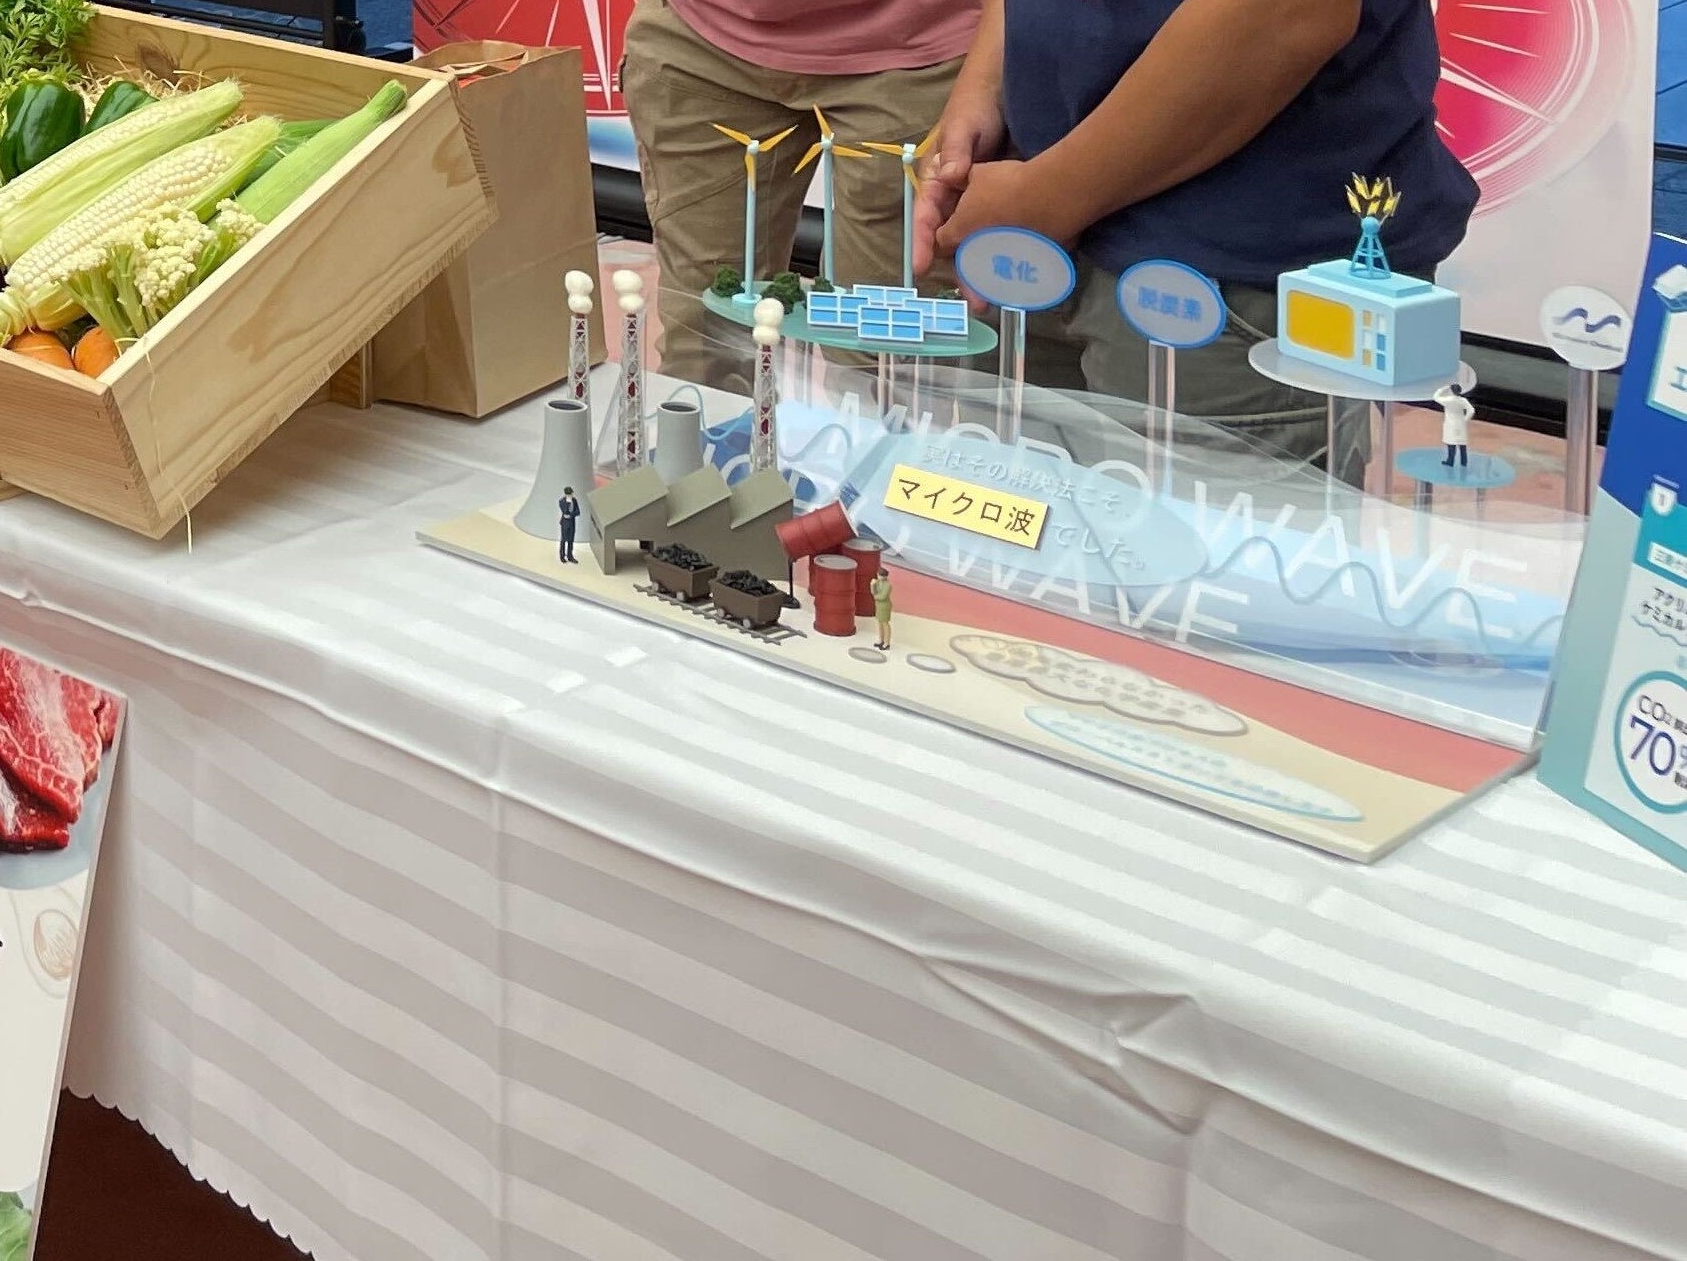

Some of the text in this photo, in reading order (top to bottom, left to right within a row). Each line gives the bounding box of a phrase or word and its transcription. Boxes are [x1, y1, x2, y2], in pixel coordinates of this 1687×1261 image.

[898, 478, 1036, 536] マイクロ波
